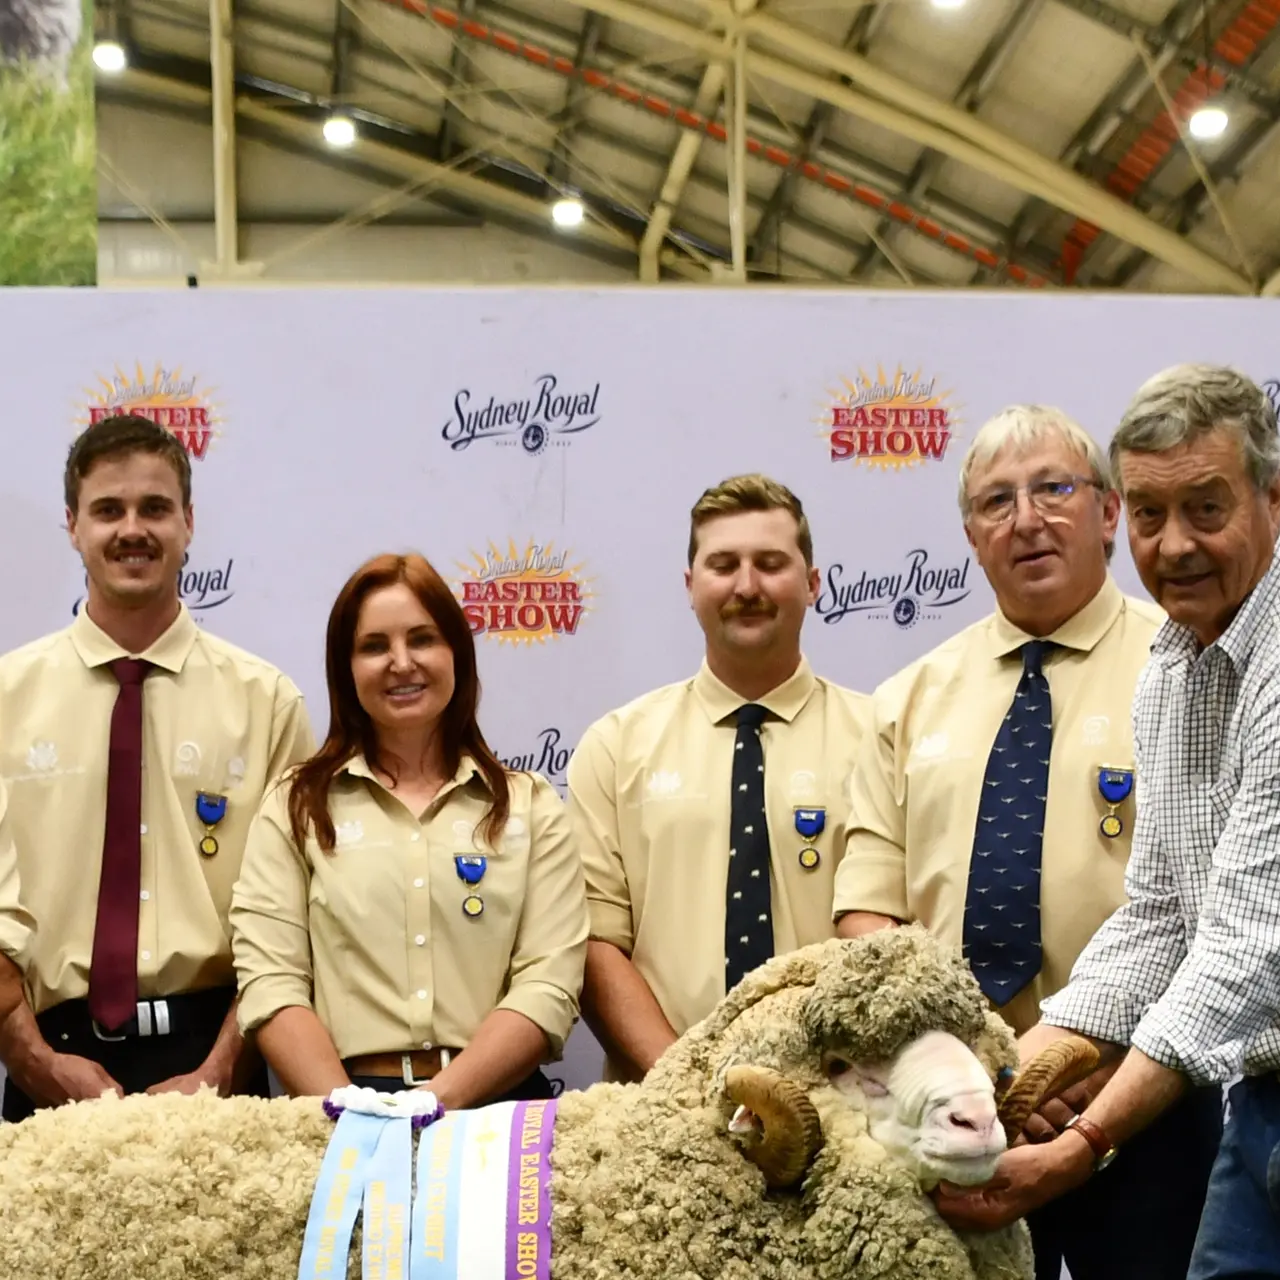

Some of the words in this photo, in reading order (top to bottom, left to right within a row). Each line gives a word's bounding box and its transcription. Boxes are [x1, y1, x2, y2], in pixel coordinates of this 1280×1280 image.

[442, 389, 531, 451] Sydney
[533, 374, 600, 429] Royal
[831, 408, 949, 429] EASTER
[830, 430, 951, 461] SHOW
[462, 582, 582, 603] EASTER
[815, 564, 902, 624] Sydney
[905, 549, 971, 603] Royal
[466, 604, 584, 636] SHOW
[521, 1107, 542, 1148] ROYAL
[518, 1151, 540, 1225] EASTER
